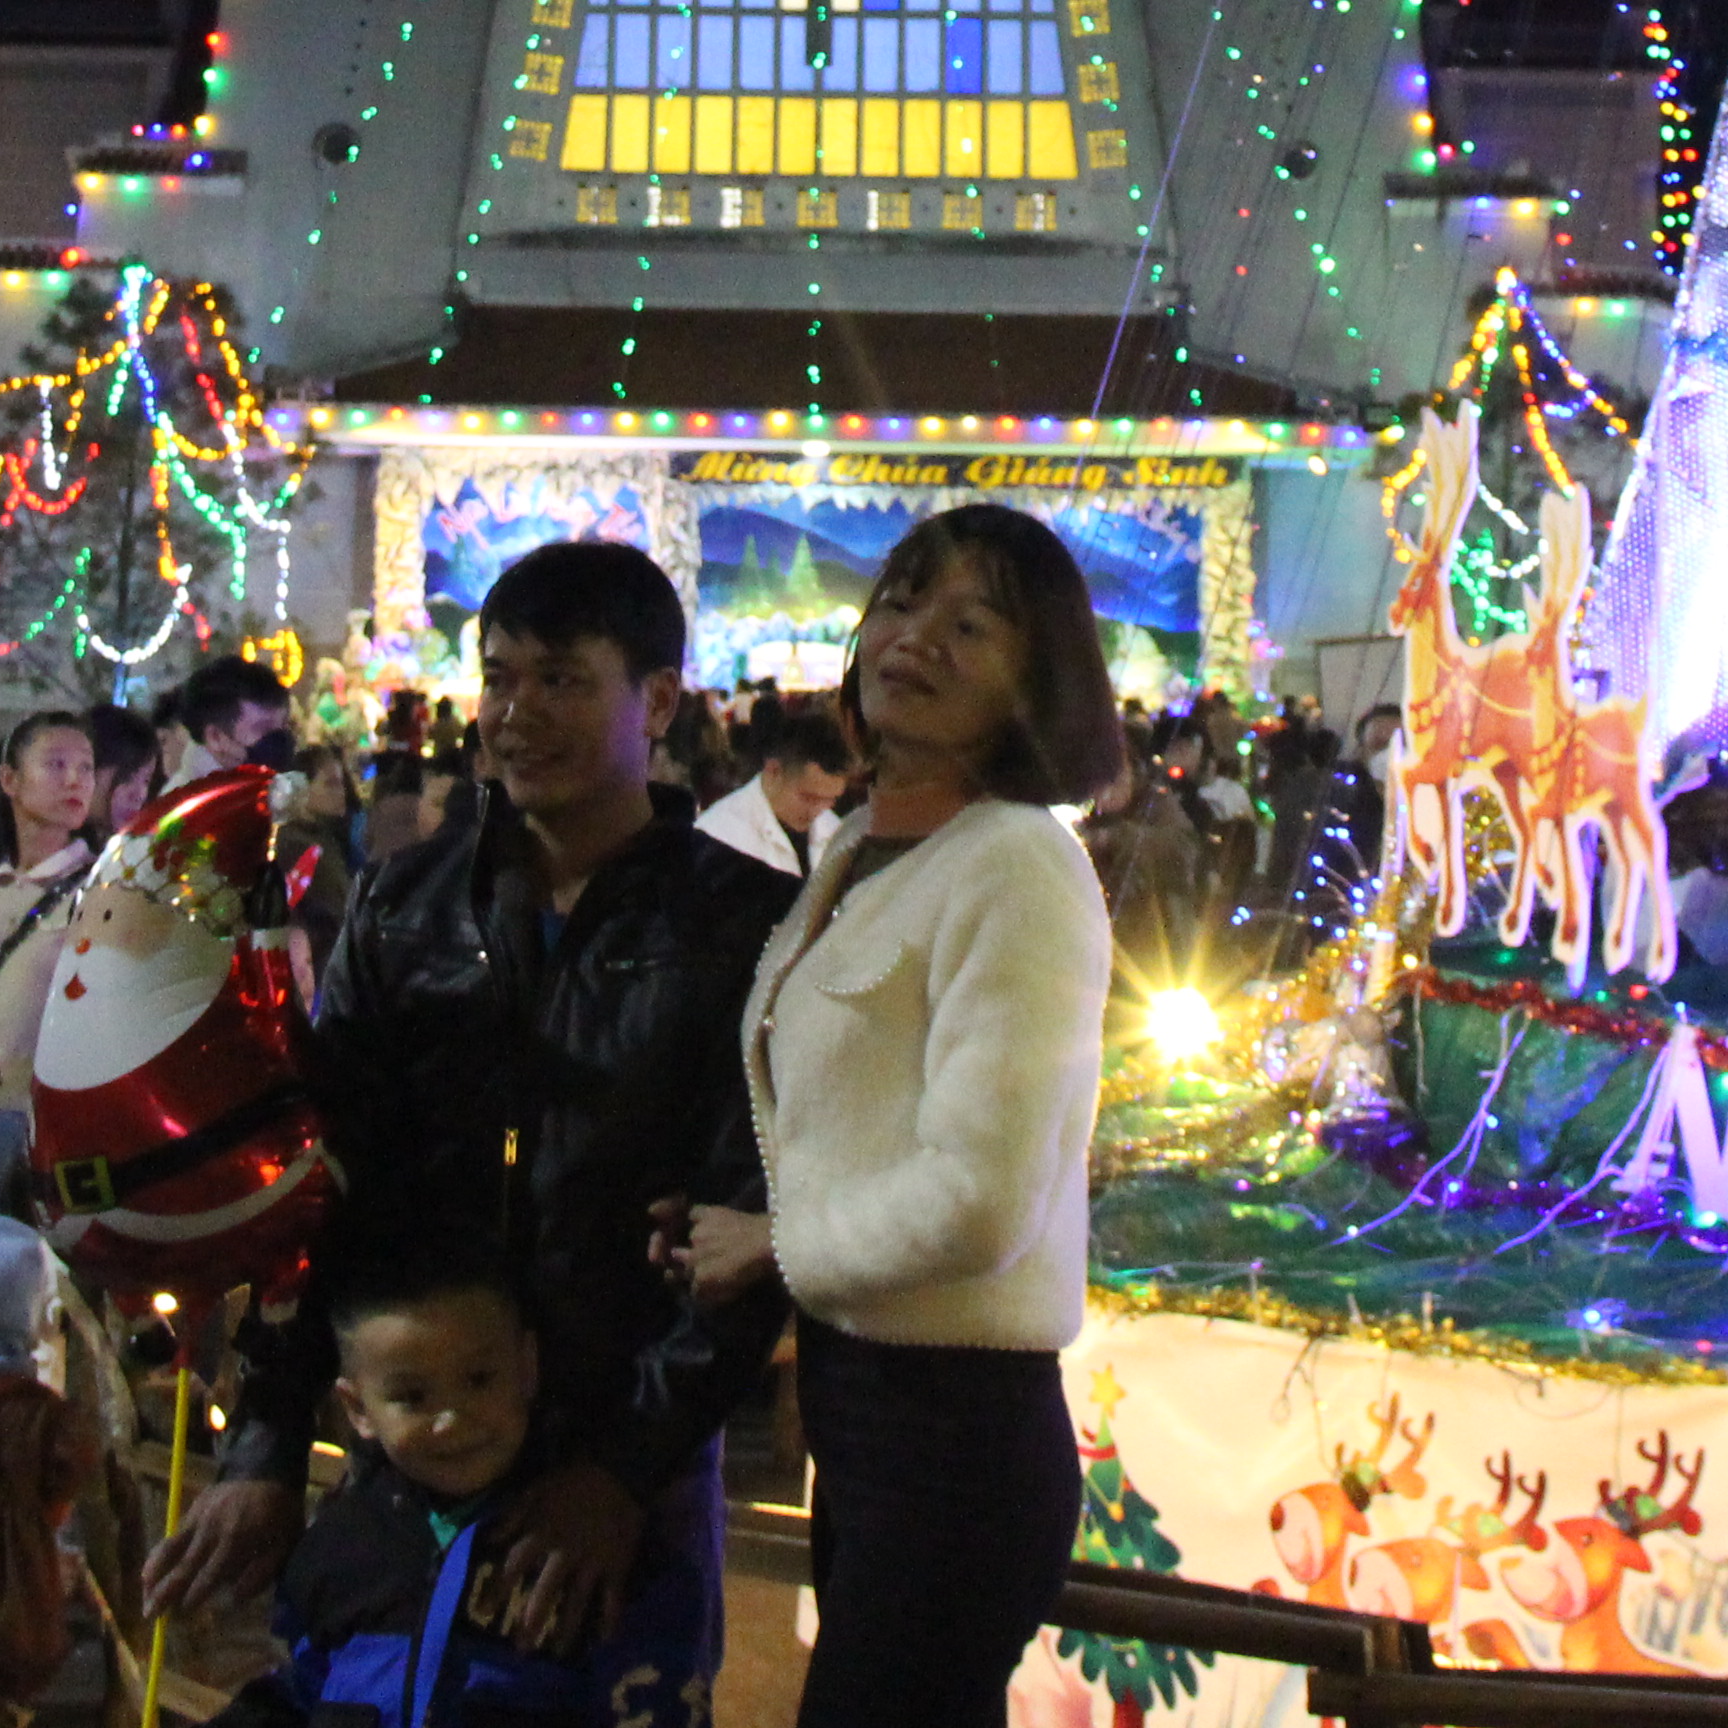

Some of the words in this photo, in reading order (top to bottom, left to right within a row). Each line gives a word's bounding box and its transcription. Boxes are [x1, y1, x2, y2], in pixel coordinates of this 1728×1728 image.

[829, 453, 949, 484] Chúa
[963, 453, 1107, 490] Giáng
[1122, 456, 1228, 486] Sinh
